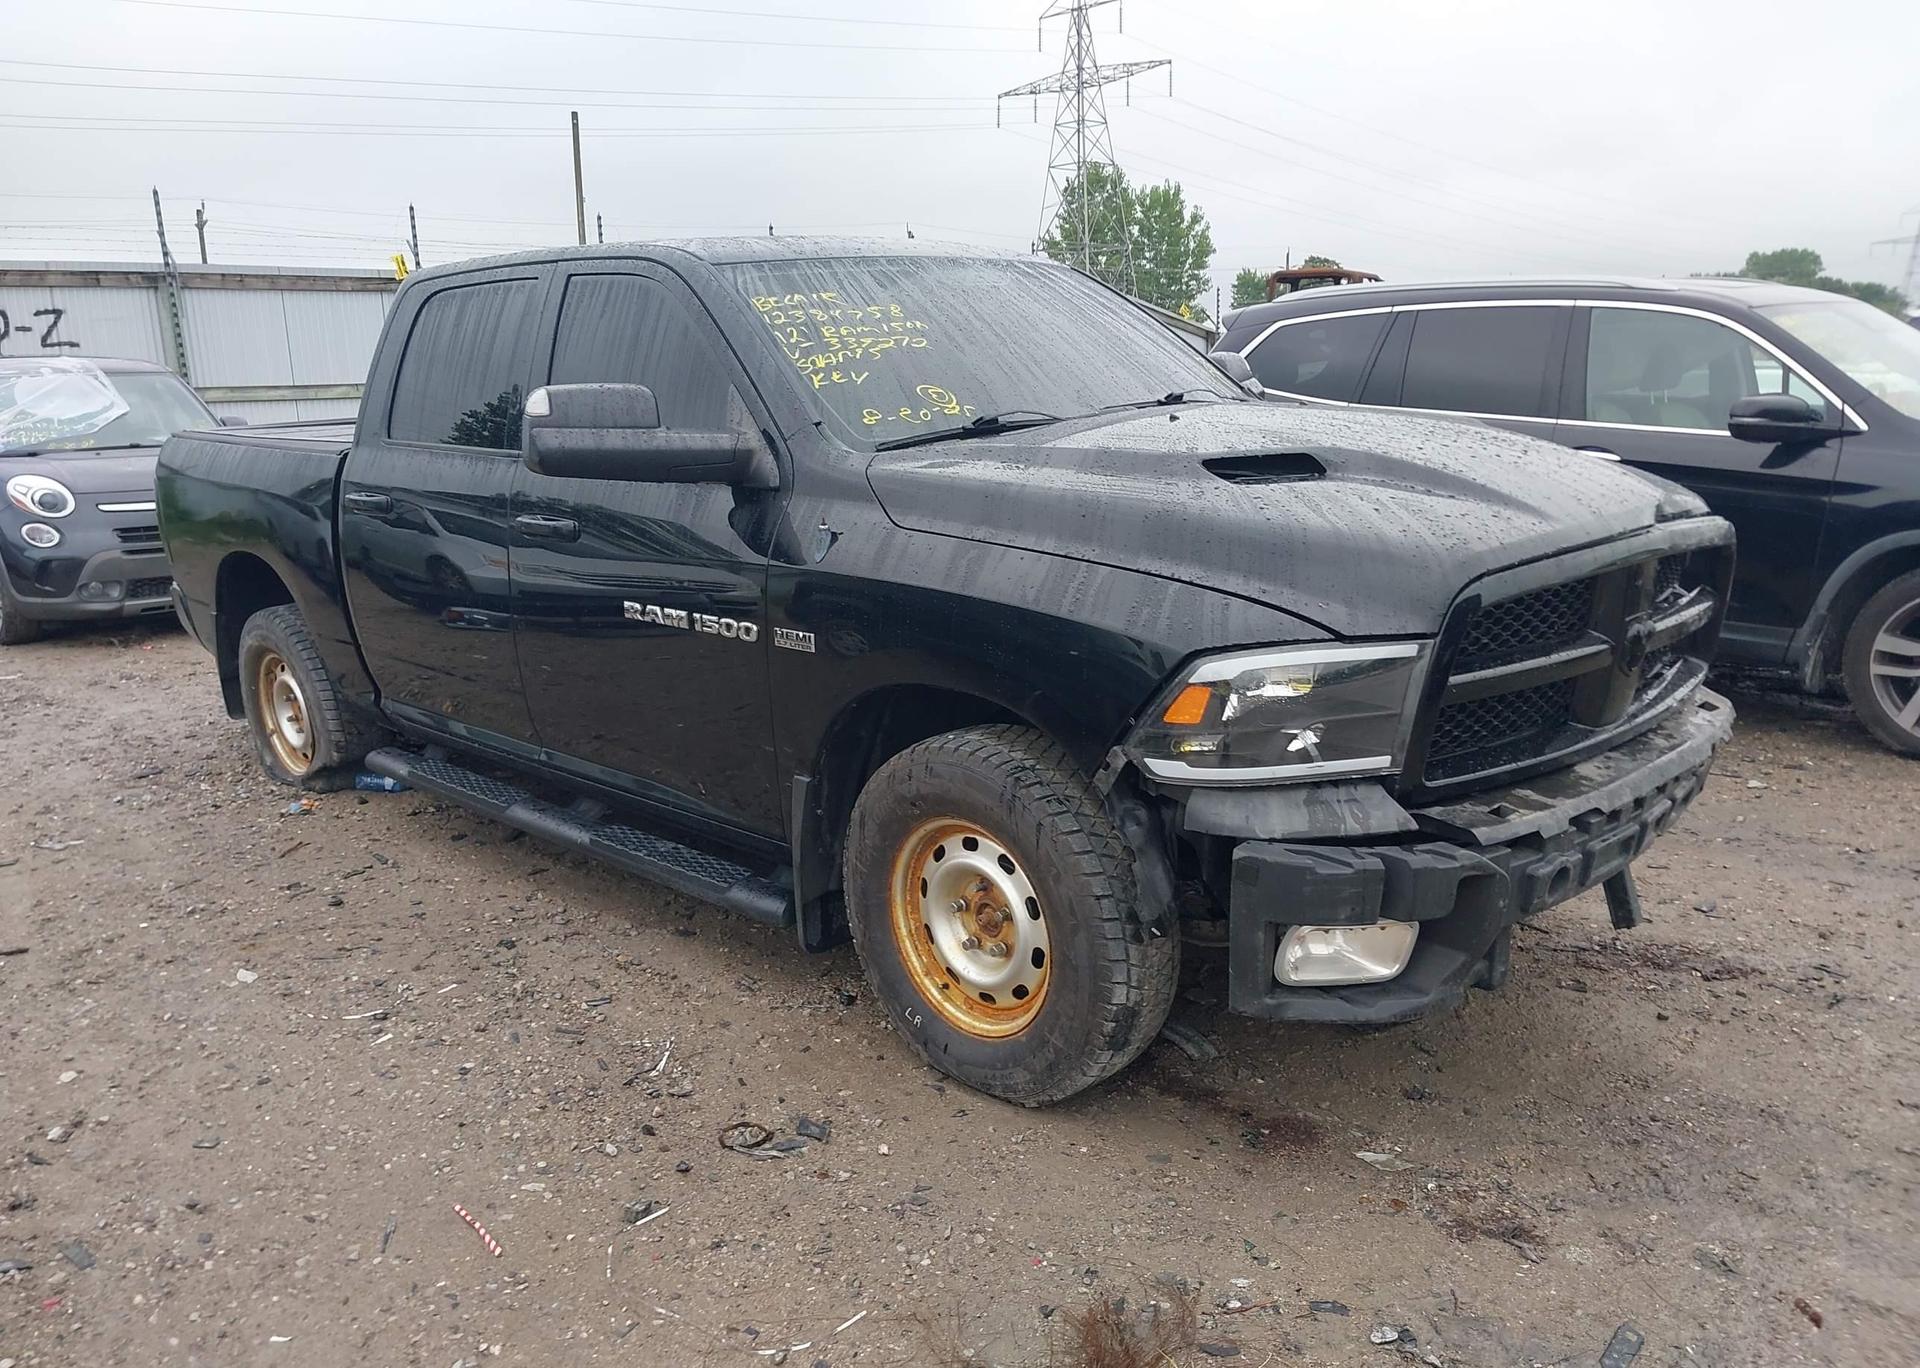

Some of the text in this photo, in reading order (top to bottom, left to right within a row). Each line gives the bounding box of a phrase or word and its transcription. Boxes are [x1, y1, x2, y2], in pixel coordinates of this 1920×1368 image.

[623, 600, 759, 642] RAM 1500
[774, 628, 813, 646] HEMI
